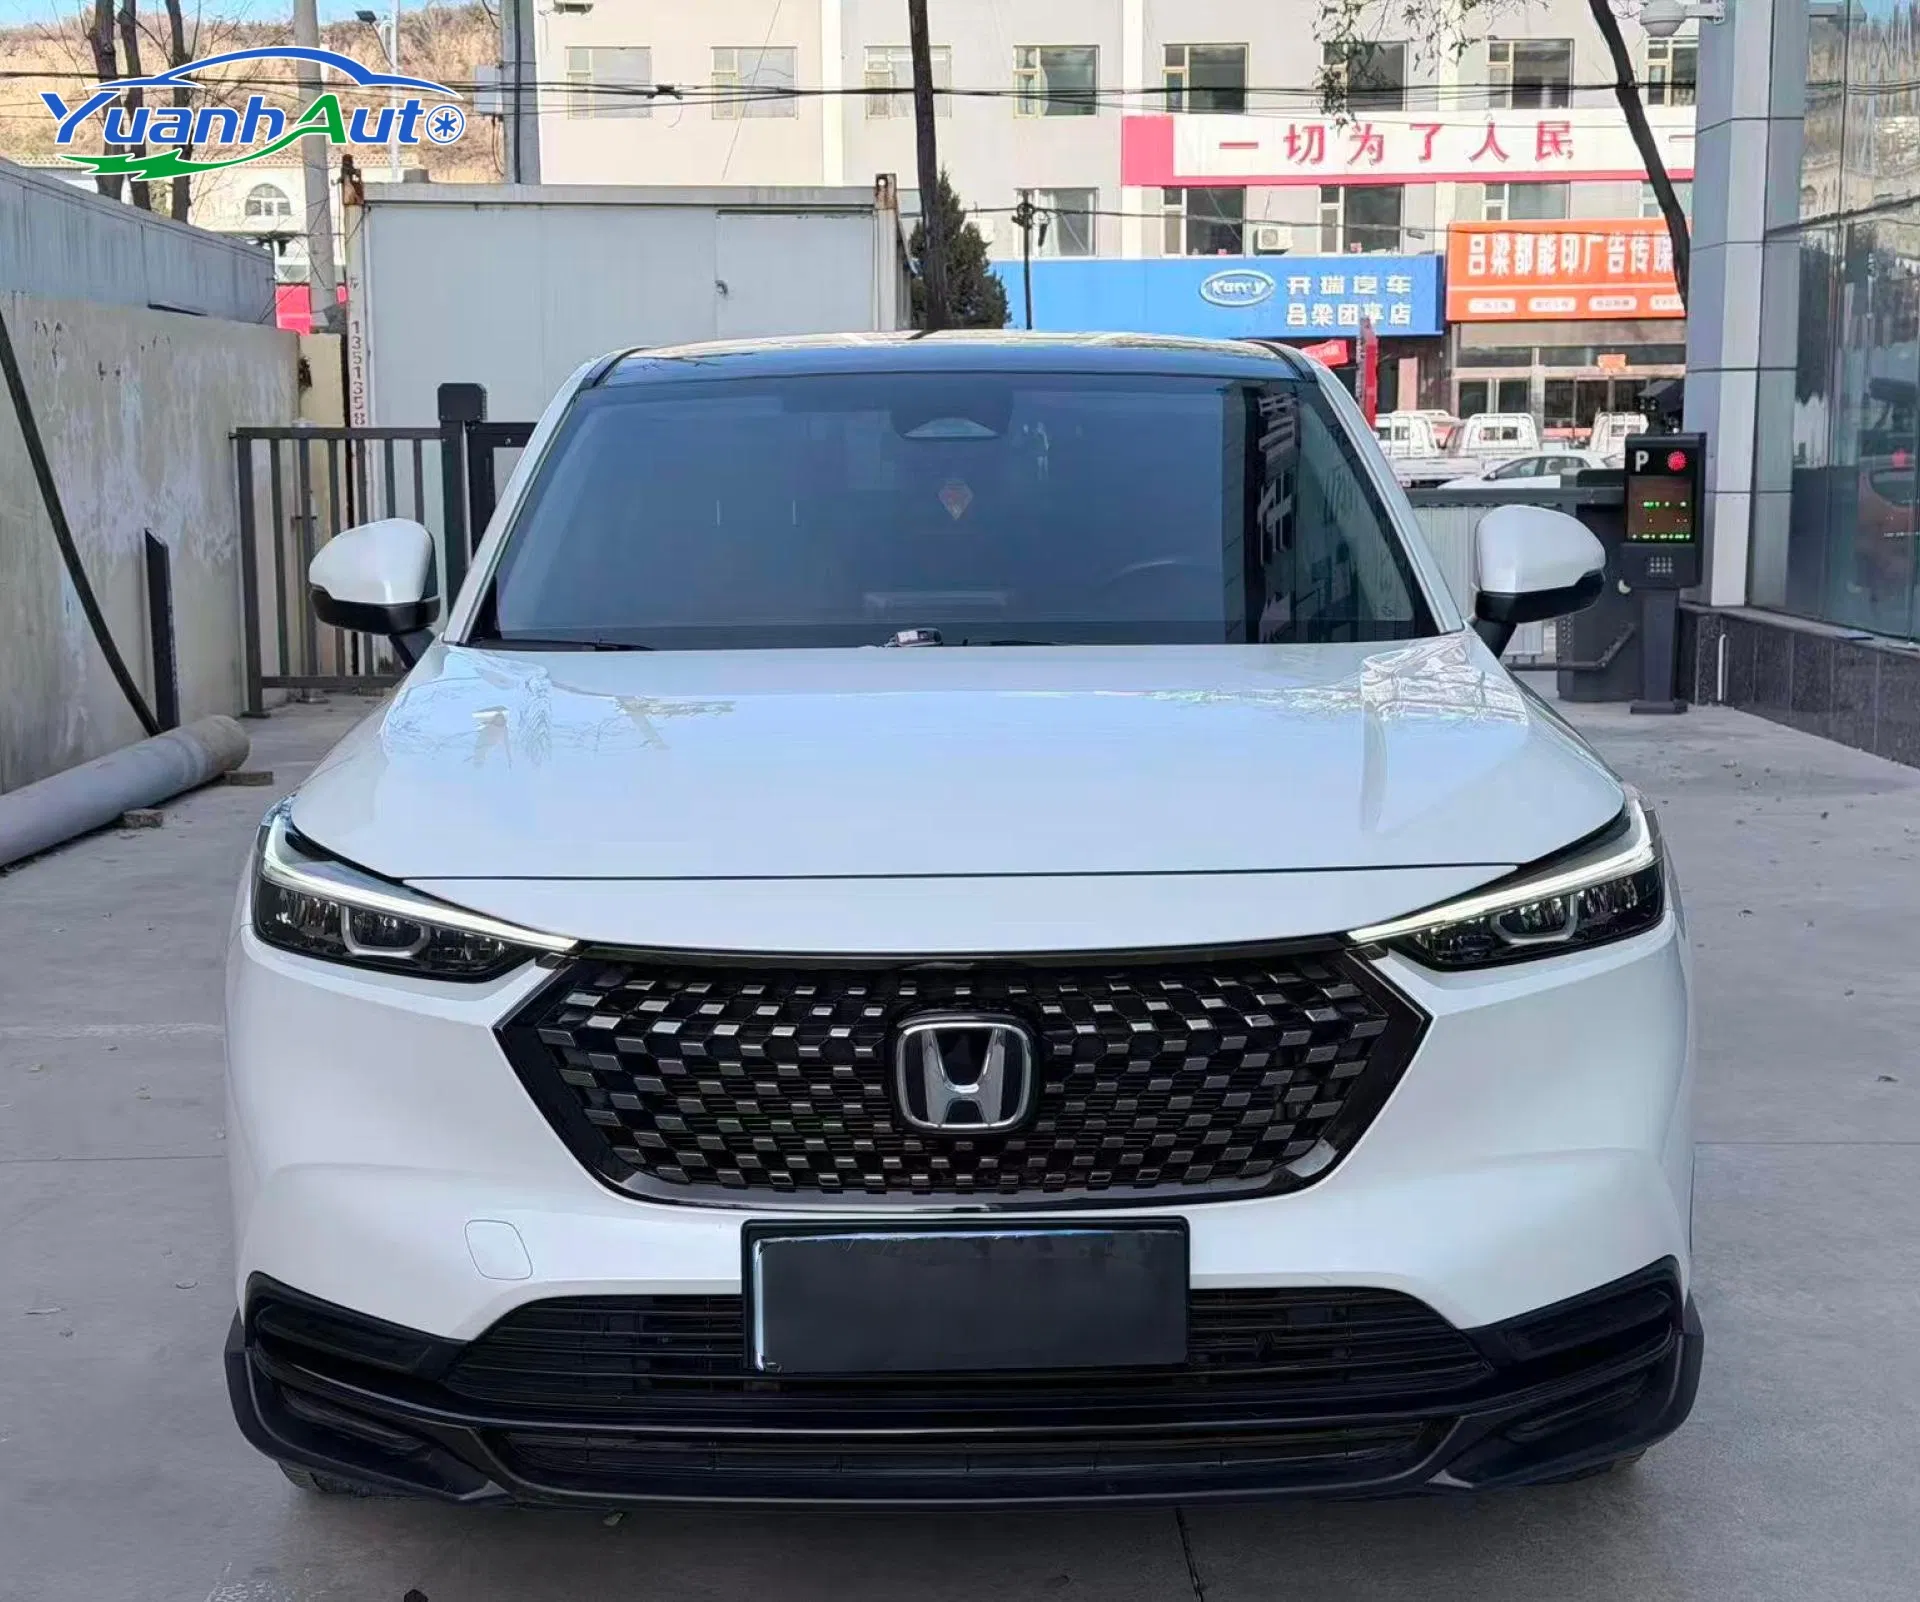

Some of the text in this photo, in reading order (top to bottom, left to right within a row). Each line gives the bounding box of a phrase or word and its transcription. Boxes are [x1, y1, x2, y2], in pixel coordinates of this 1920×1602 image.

[1219, 119, 1574, 165] 一切为了人民
[1287, 276, 1412, 295] 开瑞汽车
[1635, 450, 1649, 472] P
